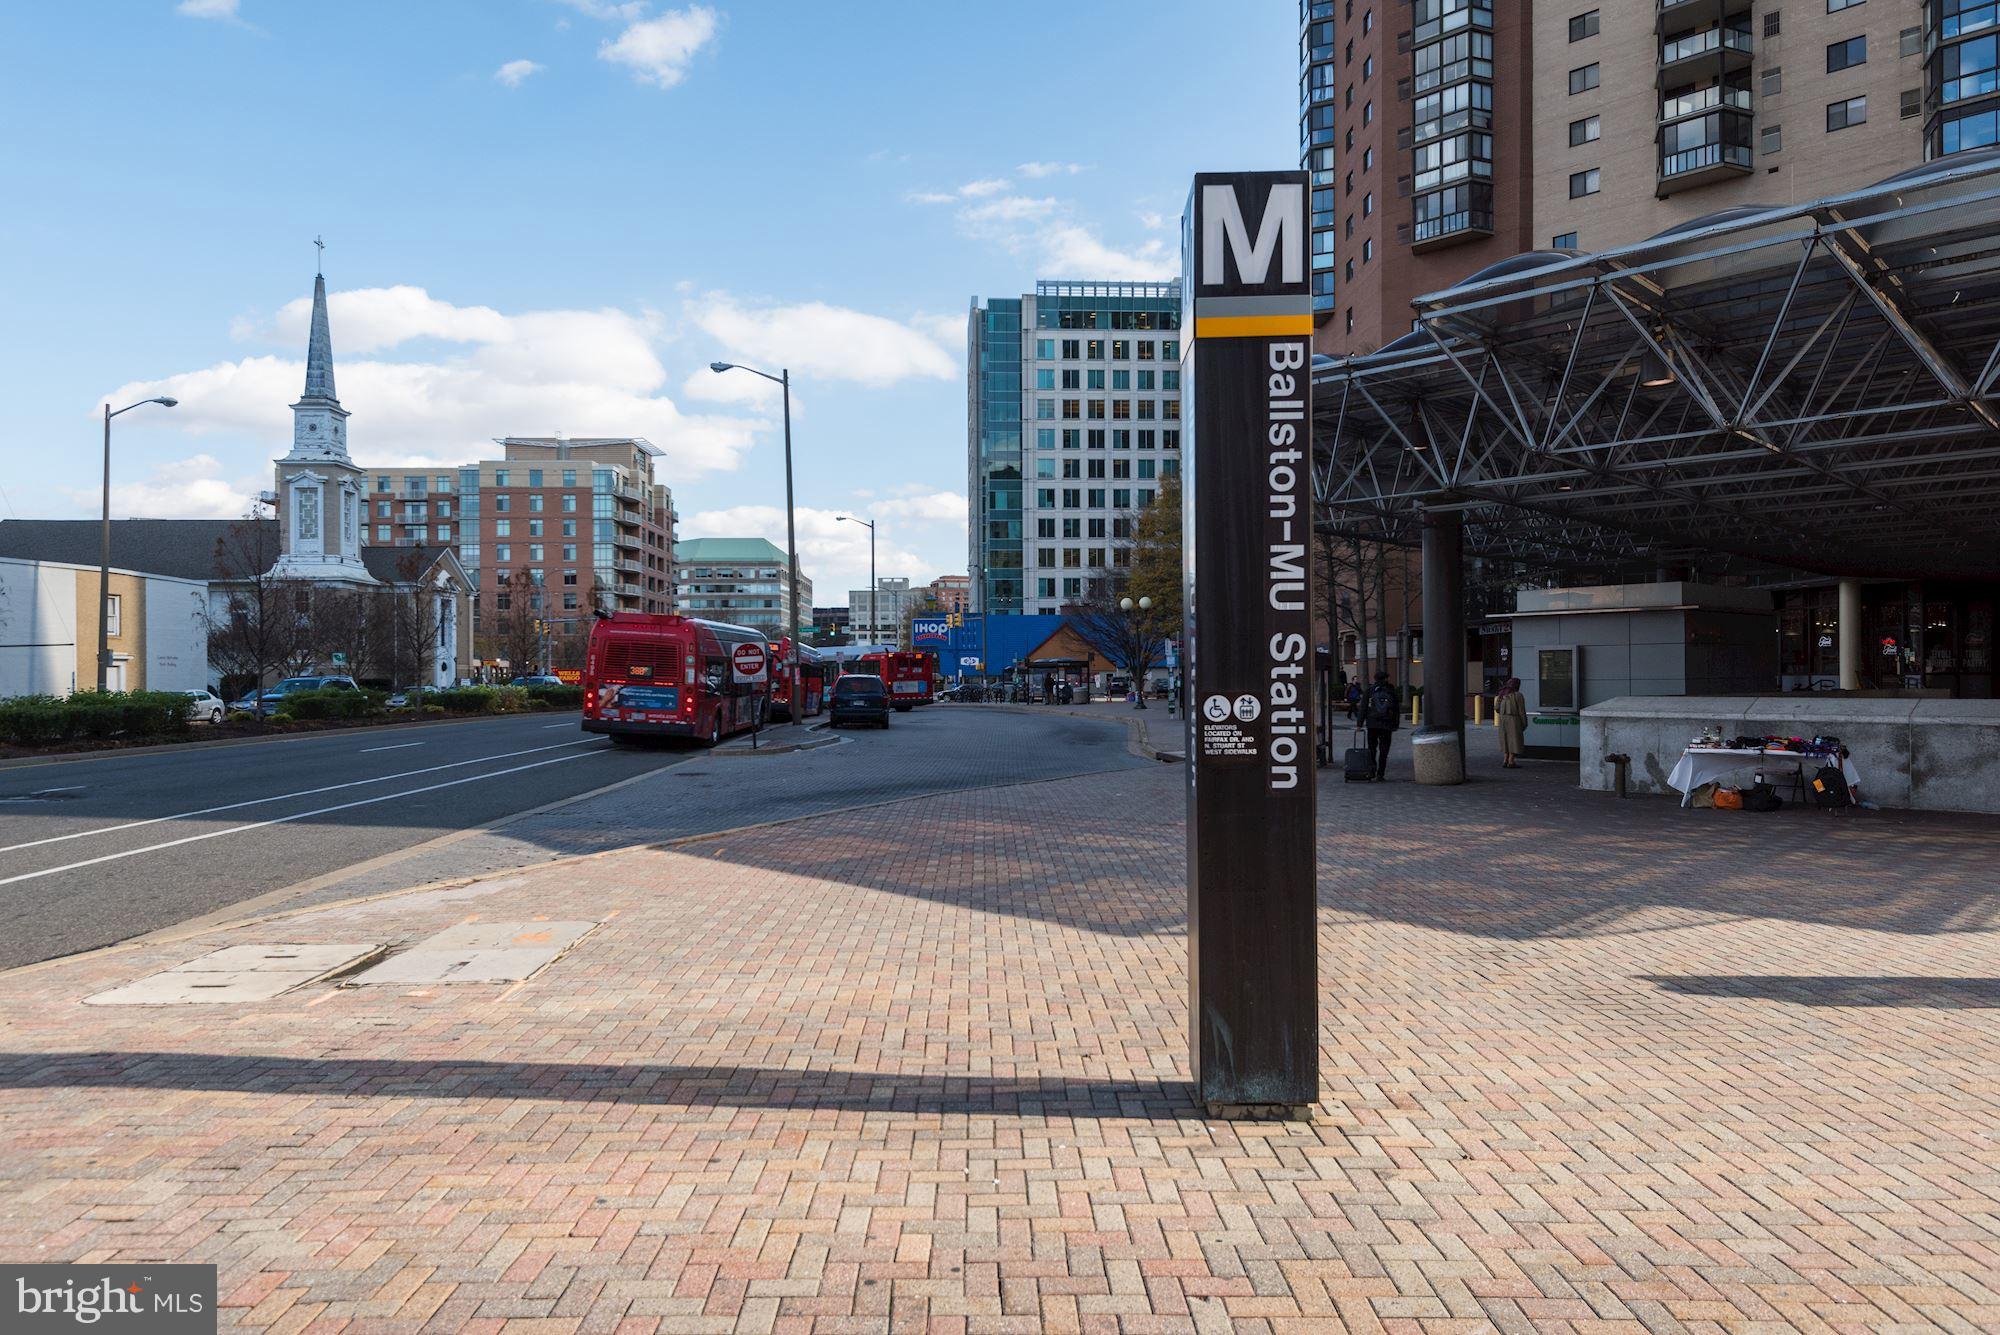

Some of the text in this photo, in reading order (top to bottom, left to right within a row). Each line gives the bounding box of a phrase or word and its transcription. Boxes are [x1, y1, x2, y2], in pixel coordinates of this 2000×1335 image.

[1203, 184, 1303, 285] M
[1269, 343, 1306, 788] Ballston-MU Station
[915, 623, 948, 635] IHOP
